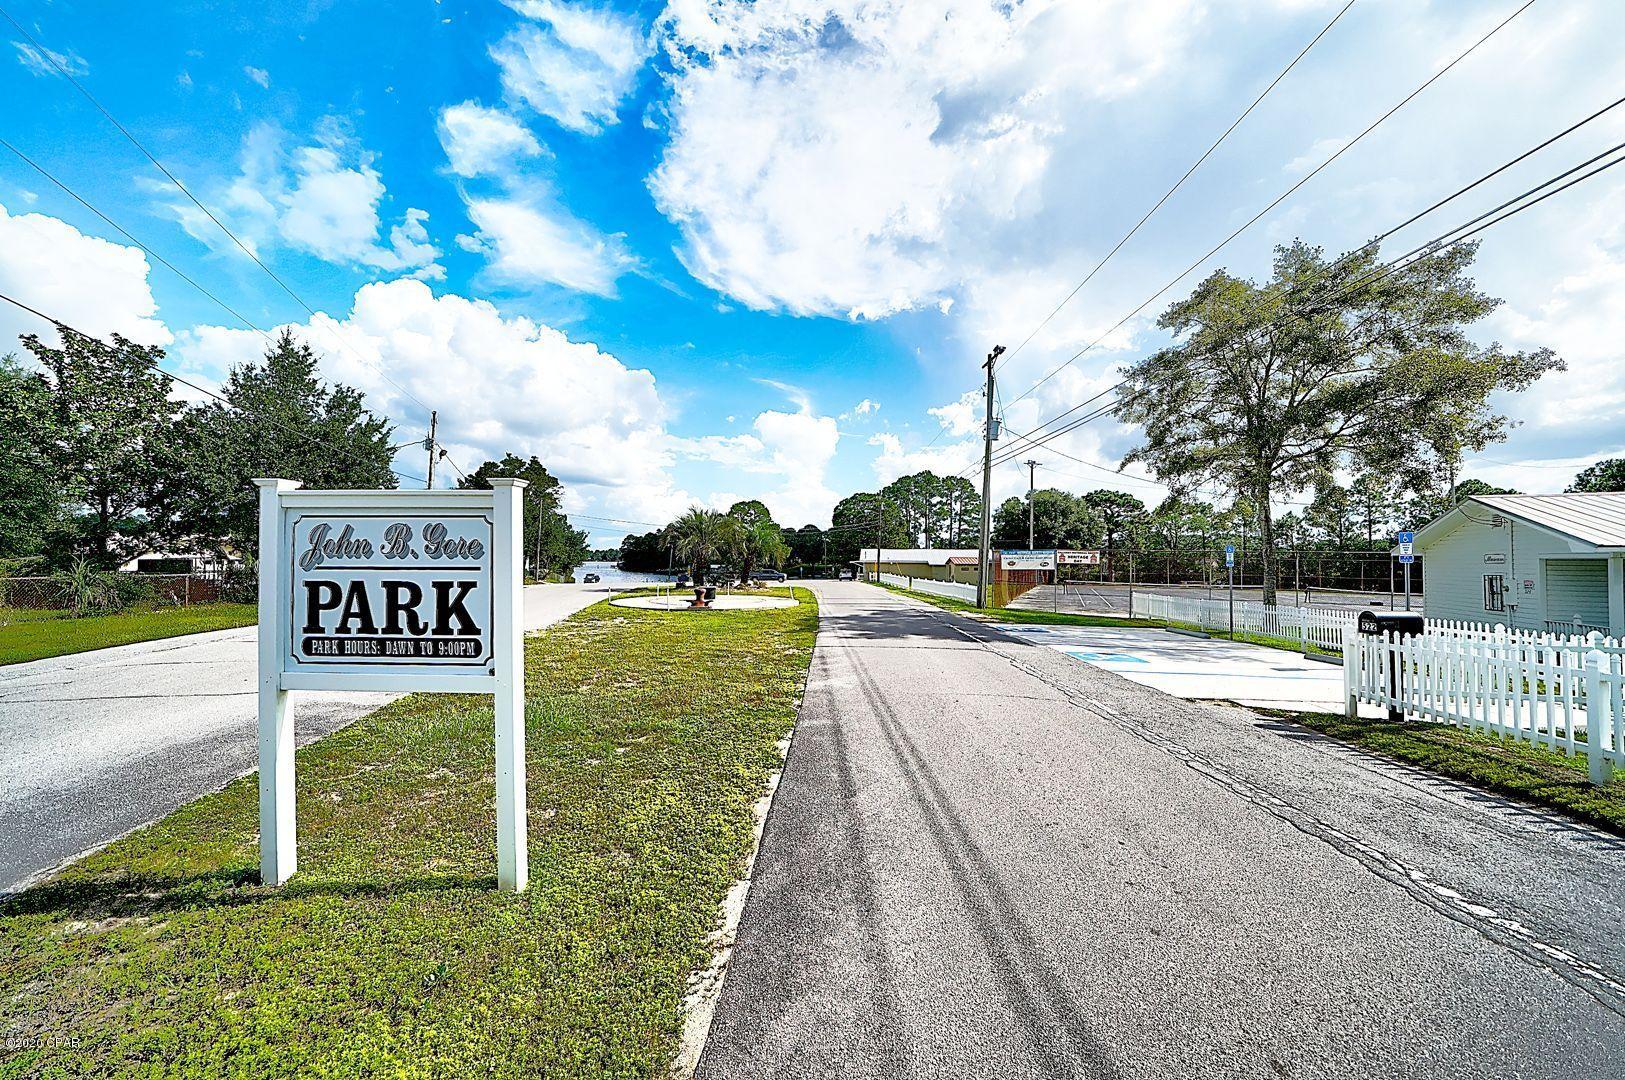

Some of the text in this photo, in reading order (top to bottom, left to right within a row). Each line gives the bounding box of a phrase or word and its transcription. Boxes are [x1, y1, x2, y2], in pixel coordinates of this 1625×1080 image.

[299, 522, 485, 572] John B. Gore
[302, 580, 482, 636] PARK
[1361, 621, 1378, 632] 522
[311, 639, 475, 656] PARK HOURS: DAWN TO 9:00PM
